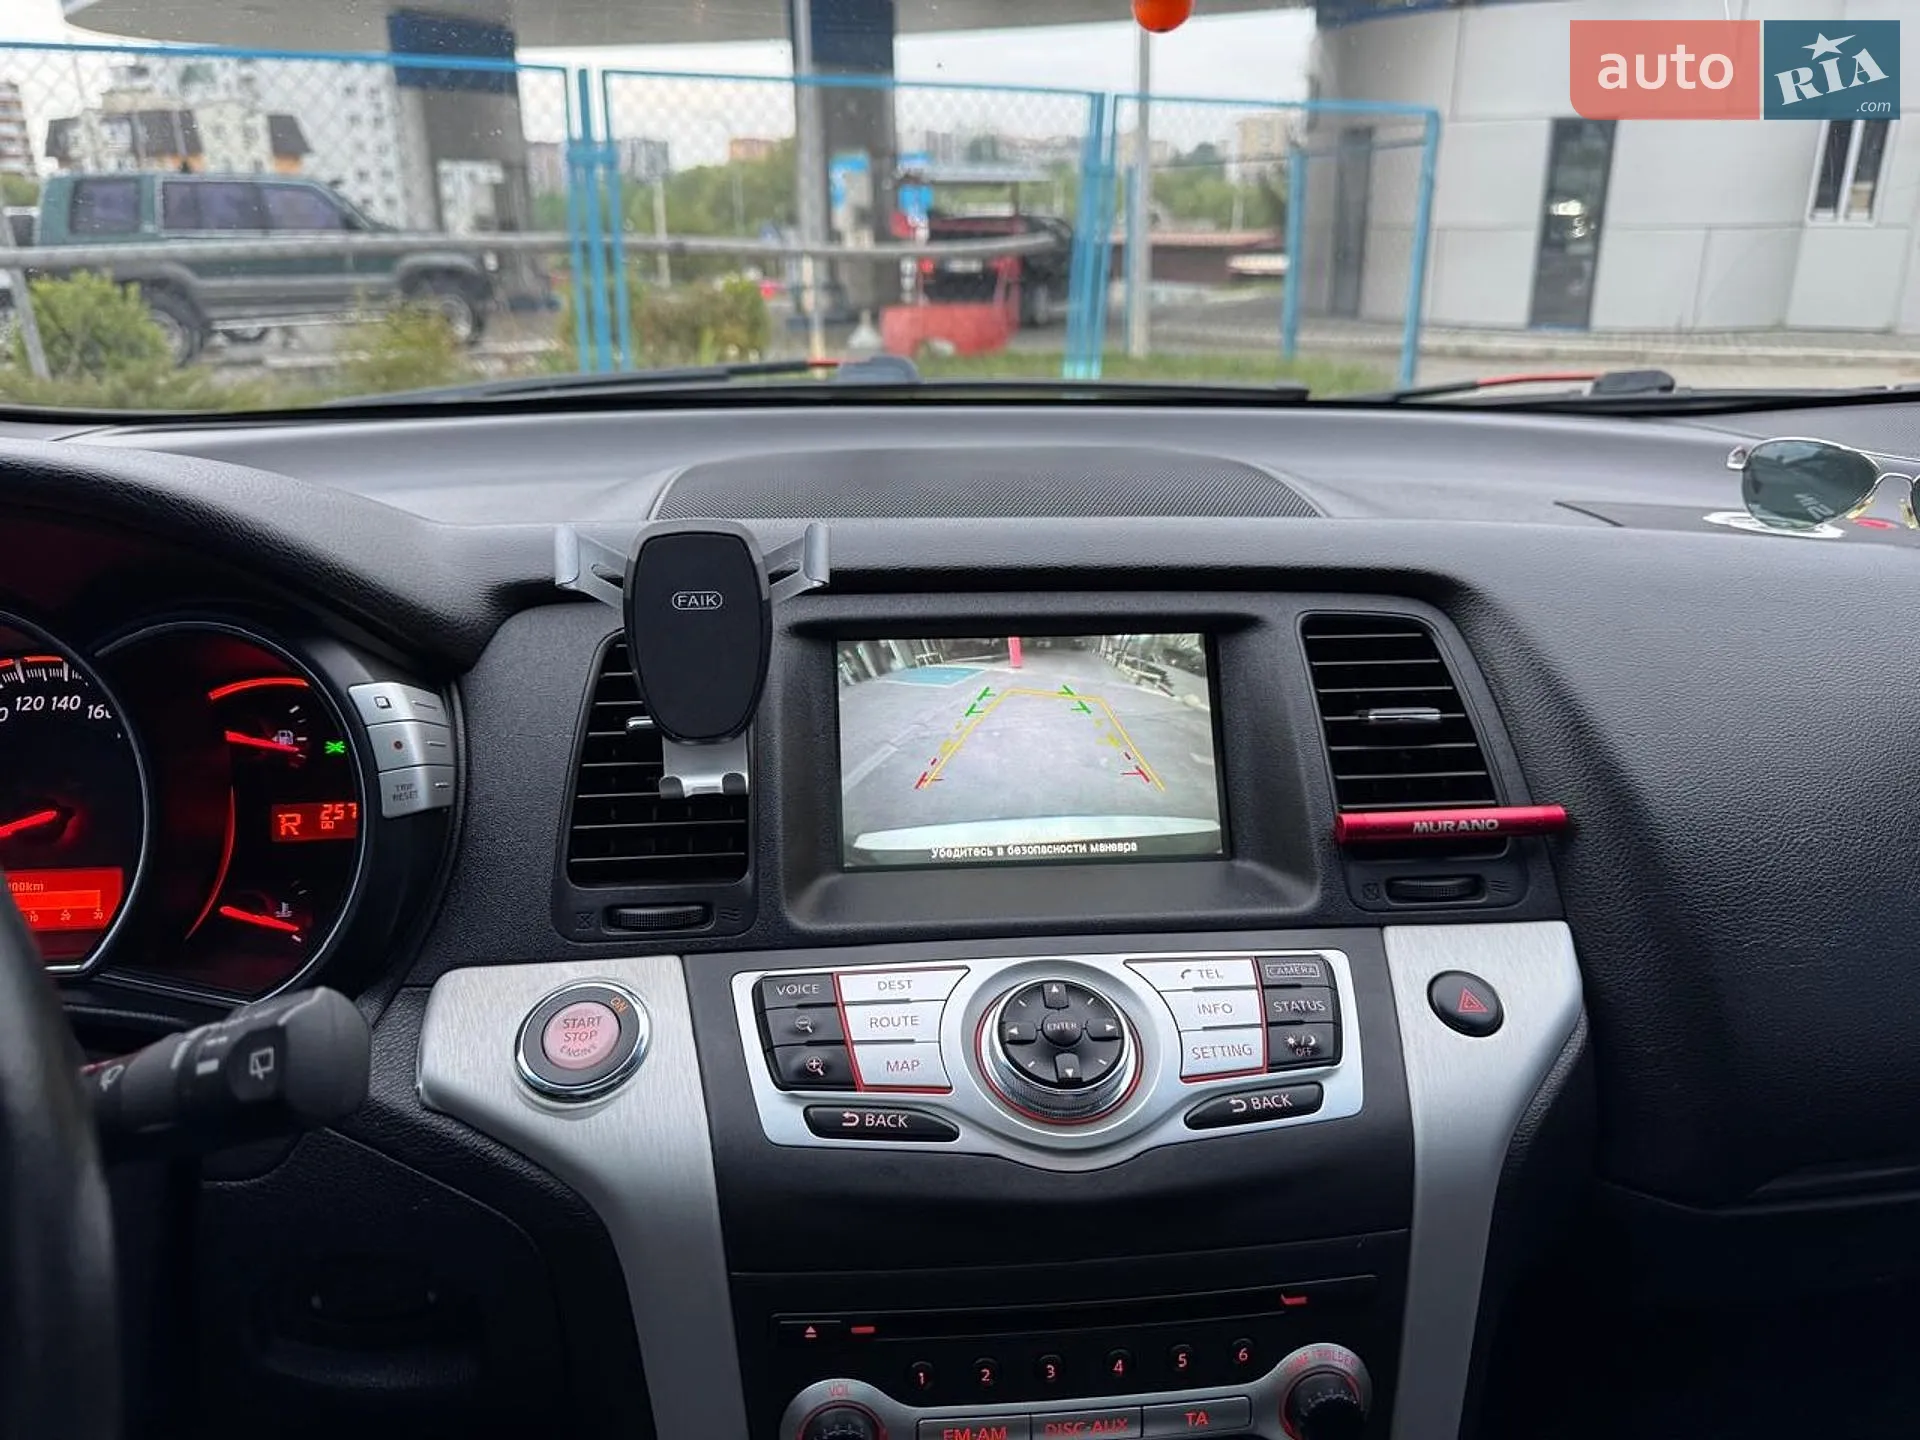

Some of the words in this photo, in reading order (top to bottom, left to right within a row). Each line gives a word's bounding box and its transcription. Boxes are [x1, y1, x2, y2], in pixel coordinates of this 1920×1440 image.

[677, 594, 717, 607] FAIK
[15, 695, 45, 712] 120
[51, 694, 81, 711] 140
[320, 803, 357, 820] 257
[278, 813, 302, 836] R
[1413, 818, 1500, 833] MURANO
[1197, 968, 1224, 981] TEL
[1268, 965, 1317, 976] CAMERA
[776, 984, 820, 996] VOICE
[877, 979, 913, 991] DEST
[611, 998, 627, 1013] ON
[1197, 1002, 1233, 1015] INFO
[1273, 1000, 1326, 1013] STATUS
[562, 1016, 601, 1030] START
[869, 1015, 920, 1029] ROUTE
[1046, 1020, 1077, 1031] ENTER
[563, 1031, 599, 1043] STOP
[1191, 1043, 1253, 1060] SETTING
[1295, 1047, 1312, 1057] OFF
[885, 1059, 921, 1073] MAP
[1250, 1093, 1293, 1110] BACK
[865, 1114, 909, 1129] BACK
[1237, 1346, 1248, 1361] 6
[1113, 1358, 1124, 1375] 4
[1177, 1353, 1187, 1369] 5
[918, 1372, 924, 1385] 1
[981, 1368, 990, 1382] 2
[1046, 1364, 1055, 1379] 3
[1184, 1411, 1208, 1427] TA
